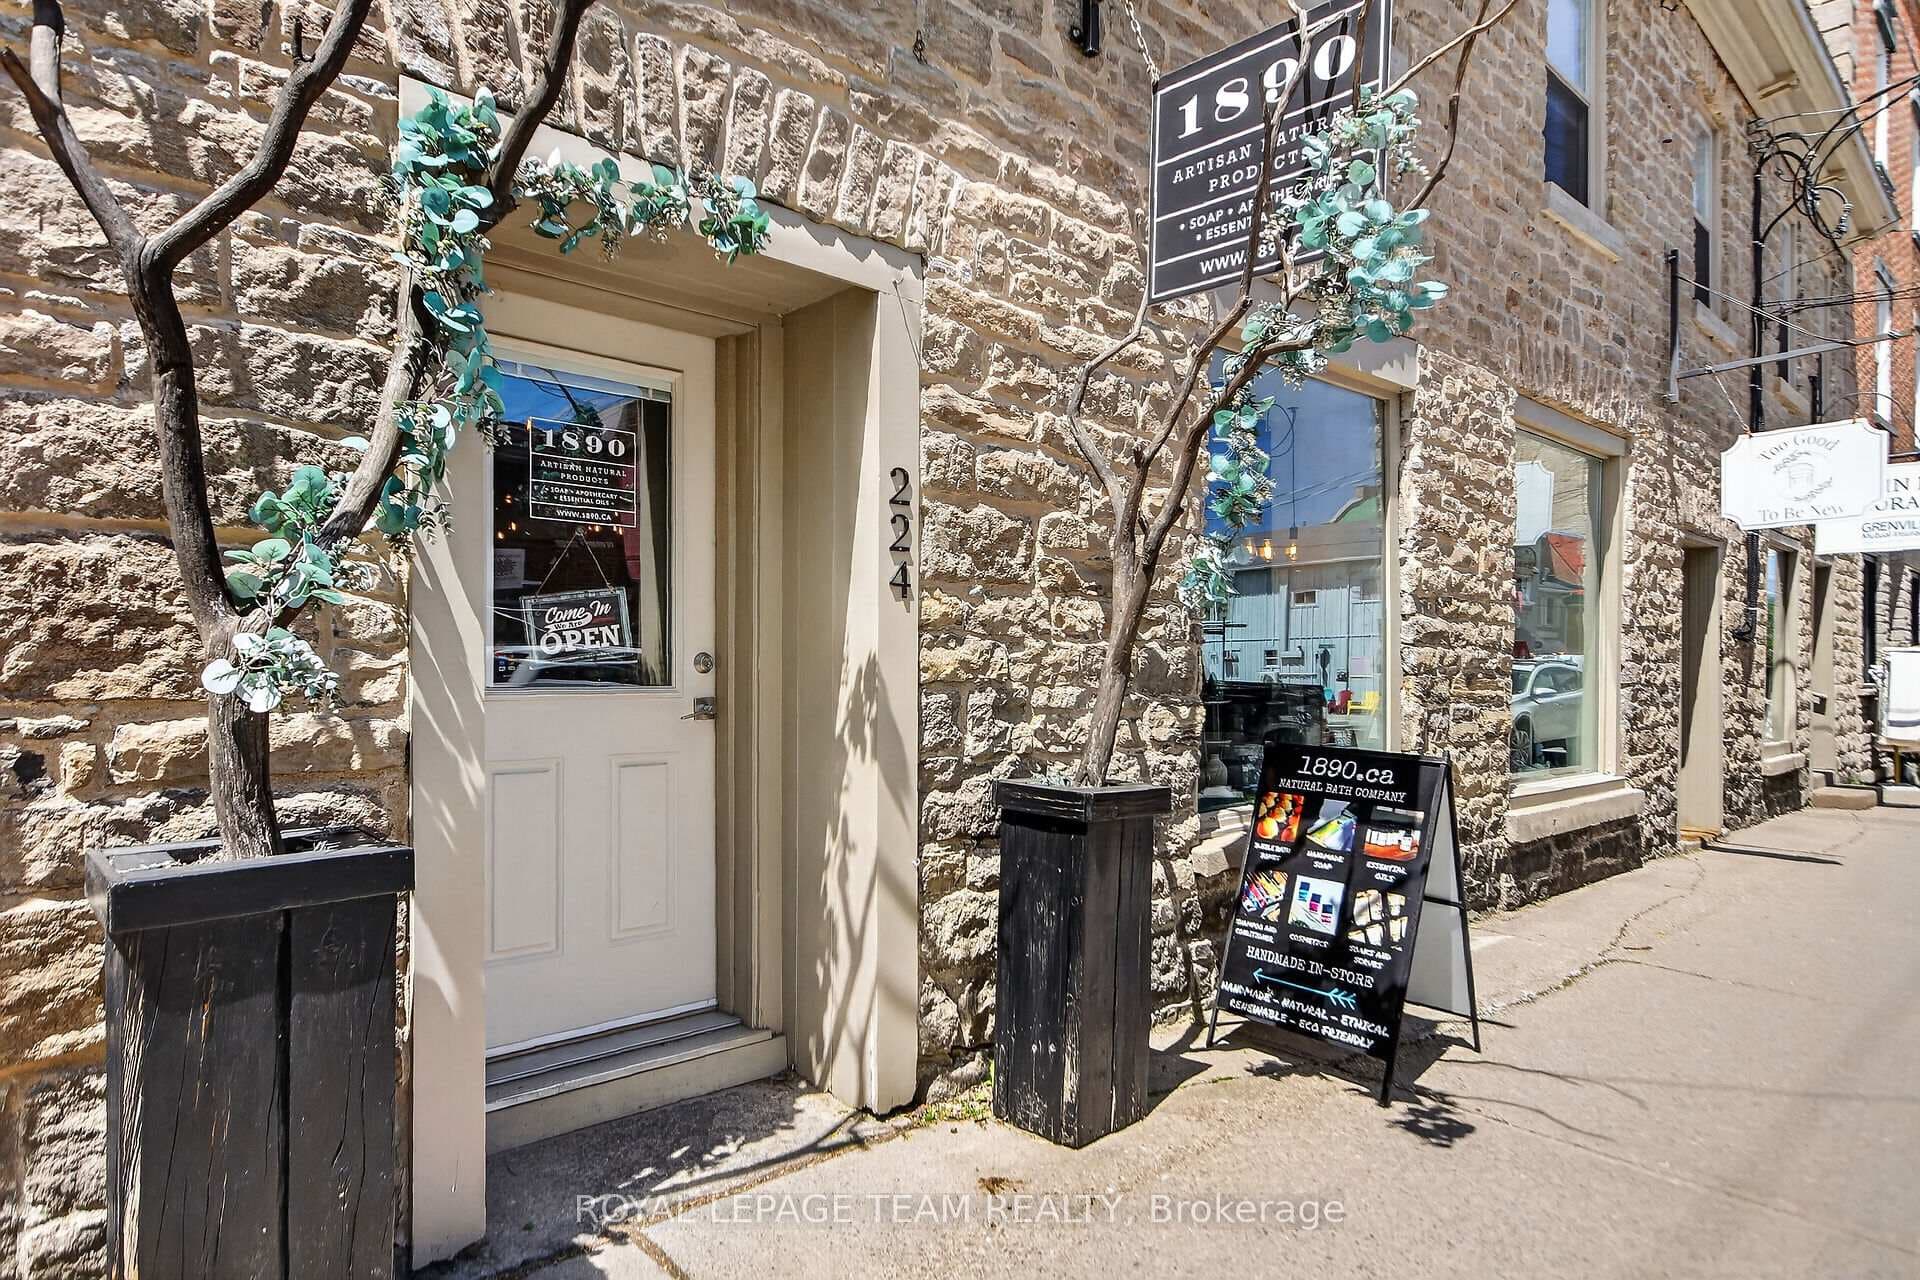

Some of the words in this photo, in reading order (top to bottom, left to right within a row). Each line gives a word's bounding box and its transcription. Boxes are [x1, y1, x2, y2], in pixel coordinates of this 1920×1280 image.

[1177, 35, 1356, 139] 1890
[1172, 144, 1251, 184] ARTISAN
[1189, 209, 1223, 230] SOAP
[543, 429, 625, 456] 1890
[540, 460, 582, 471] ARTISAN
[585, 466, 626, 477] NATURAL
[560, 473, 608, 484] PRODUCTS
[560, 495, 594, 504] ESSENTIAL
[575, 490, 617, 499] APOTHECARY
[556, 510, 611, 520] WWW.1890.CA
[1758, 508, 1779, 521] To
[1784, 507, 1805, 519] Be
[889, 467, 911, 598] 224
[545, 607, 585, 624] Come
[589, 600, 611, 616] In
[540, 624, 620, 654] OPEN
[1297, 755, 1394, 784] 1890.ca
[1279, 778, 1323, 792] NATURAL
[1325, 783, 1353, 796] BATH
[1355, 787, 1407, 803] COMPANY
[1246, 945, 1306, 971] HANDMADE
[1308, 961, 1375, 989] IN-STORE
[1221, 980, 1272, 1004] HANDMADE
[1281, 997, 1329, 1021] NATURAL
[1340, 1014, 1390, 1038] ETHICAL
[1299, 1018, 1319, 1033] ECO
